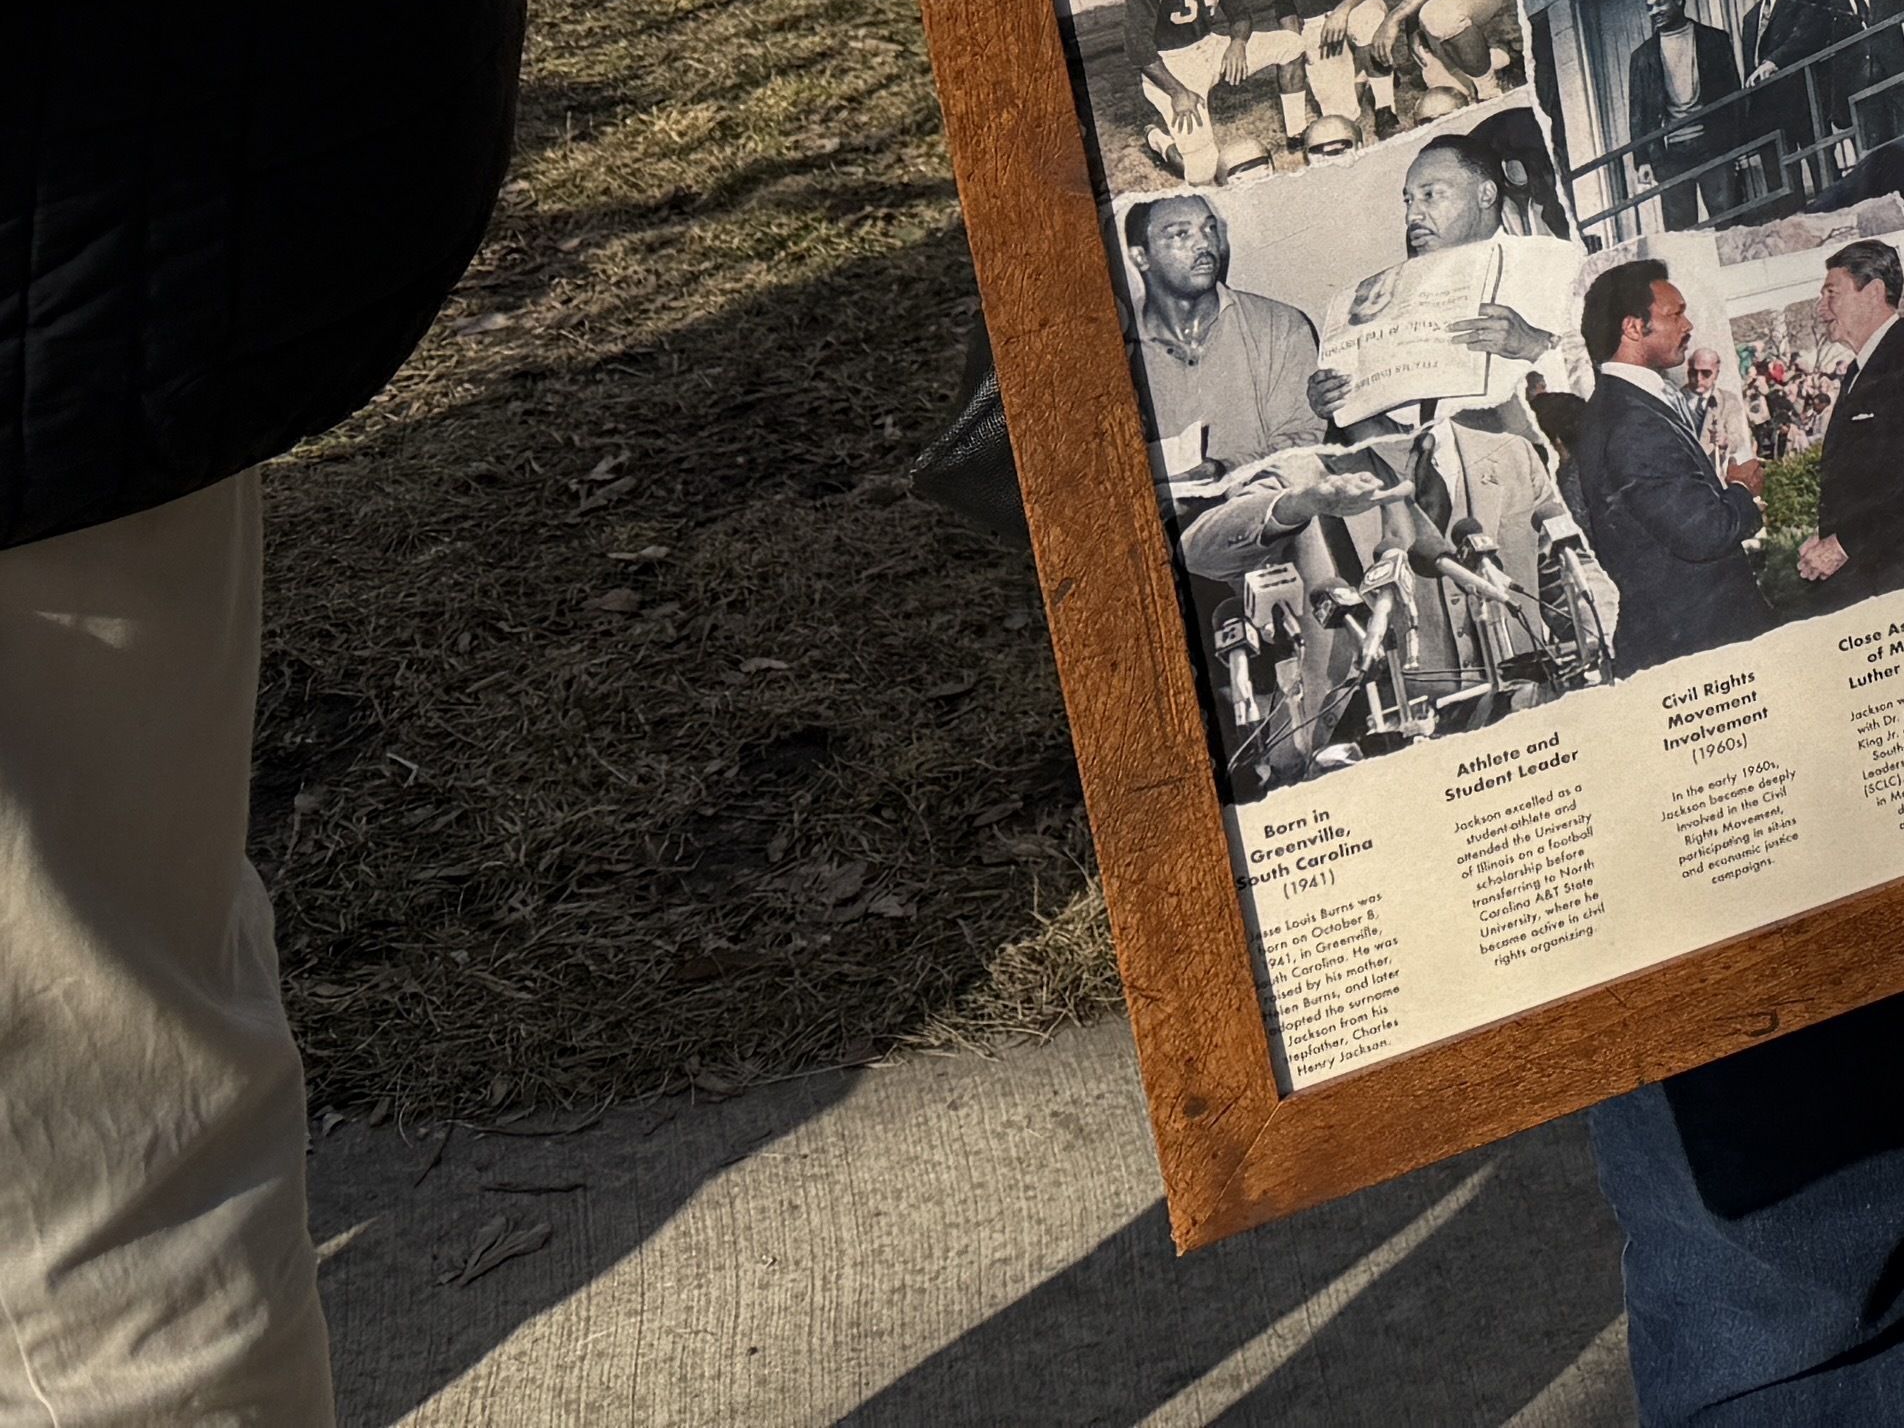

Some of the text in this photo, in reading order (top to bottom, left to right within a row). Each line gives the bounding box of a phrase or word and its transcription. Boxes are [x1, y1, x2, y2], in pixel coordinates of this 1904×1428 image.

[1838, 631, 1881, 651] Close
[1866, 645, 1883, 662] of
[1661, 671, 1755, 709] Civil Rights
[1848, 664, 1900, 689] Luther
[1663, 706, 1767, 751] Involvement
[1668, 690, 1756, 729] Movement
[1850, 701, 1893, 721] Jackson
[1856, 718, 1880, 734] with
[1456, 731, 1559, 777] Athlete and
[1692, 732, 1747, 764] (1960s)
[1857, 736, 1883, 750] King
[1444, 750, 1578, 801] Student Leader
[1263, 809, 1329, 838] Born in
[1454, 784, 1582, 833] Jackson excelled as a
[1554, 798, 1576, 815] and
[1250, 825, 1350, 863] Greenville,
[1456, 813, 1591, 864] attended the University
[1461, 865, 1472, 879] of
[1518, 849, 1533, 860] on
[1536, 845, 1544, 854] a
[1547, 825, 1593, 850] football
[1235, 839, 1373, 891] South Carolina
[1283, 868, 1334, 899] (1941)
[1471, 858, 1594, 908] transferring to North
[1476, 848, 1584, 890] scholarship before
[1479, 878, 1593, 921] Carolina A&T State
[1479, 891, 1598, 937] University, where he
[1530, 920, 1564, 936] active
[1494, 949, 1526, 966] rights
